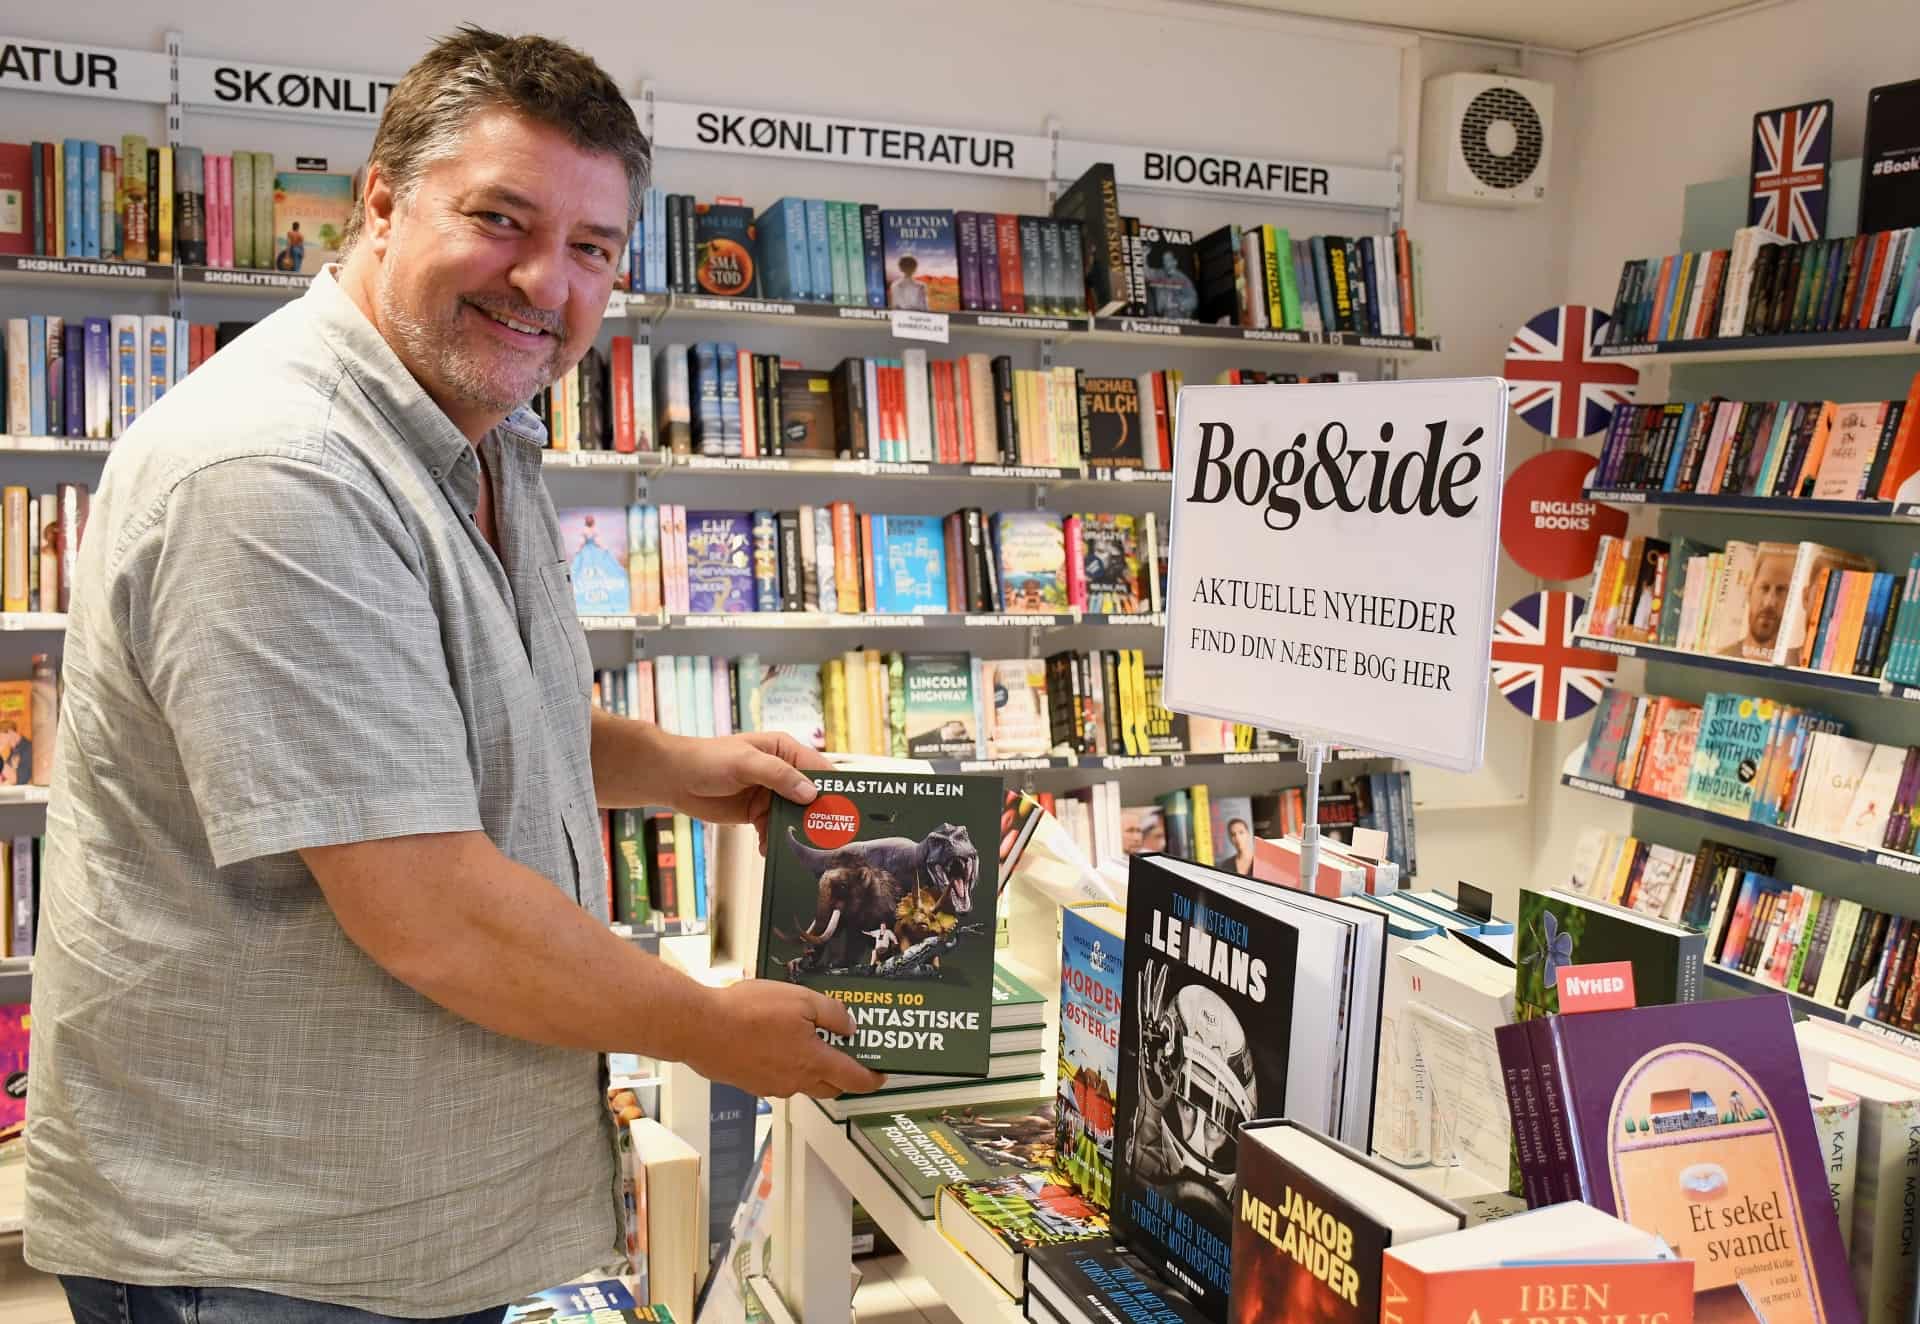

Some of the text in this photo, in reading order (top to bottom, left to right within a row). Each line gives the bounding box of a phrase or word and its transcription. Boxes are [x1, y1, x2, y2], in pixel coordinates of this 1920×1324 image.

[0, 44, 119, 90] ATUR
[696, 112, 1015, 169] SKØNLITTERATUR
[1144, 152, 1329, 196] BIOGRAFIER
[1872, 156, 1920, 176] #Book
[1162, 231, 1192, 245] VAR
[17, 258, 147, 277] SKØNLITTERATUR
[709, 253, 738, 271] SMÅ
[1086, 378, 1137, 393] MICHAEL
[1086, 393, 1139, 414] FALCH
[1186, 420, 1485, 531] Bog&idé
[1530, 500, 1597, 517] ENGLISH
[1534, 516, 1590, 530] BOOKS
[1192, 576, 1457, 636] AKTUELLE NYHEDER
[1190, 628, 1452, 691] FIND DIN NÆSTE BOG HER
[909, 675, 968, 689] LINCOLN
[911, 689, 968, 703] HIGHWAY
[813, 778, 964, 797] SEBASTIAN KLEIN
[807, 819, 856, 832] UDGAVE
[809, 812, 855, 823] OPDATERET
[1172, 892, 1191, 921] TOM
[1152, 908, 1183, 961] LE
[1187, 926, 1268, 1003] MANS
[824, 989, 924, 1006] VERDENS 100
[1066, 1001, 1120, 1048] ØSTERLE
[881, 1126, 941, 1178] FORTIDSDYR
[1831, 1130, 1845, 1173] KATE
[1131, 1199, 1167, 1244] STØRSTE
[1278, 1184, 1354, 1262] JAKOB
[1688, 1191, 1783, 1233] Et sekel
[1901, 1176, 1917, 1257] MORTON
[1175, 1207, 1193, 1240] MED
[1196, 1223, 1232, 1268] VERDEN
[1240, 1189, 1360, 1308] MELANDER
[1707, 1222, 1791, 1262] svandt
[1519, 1283, 1611, 1312] IBEN
